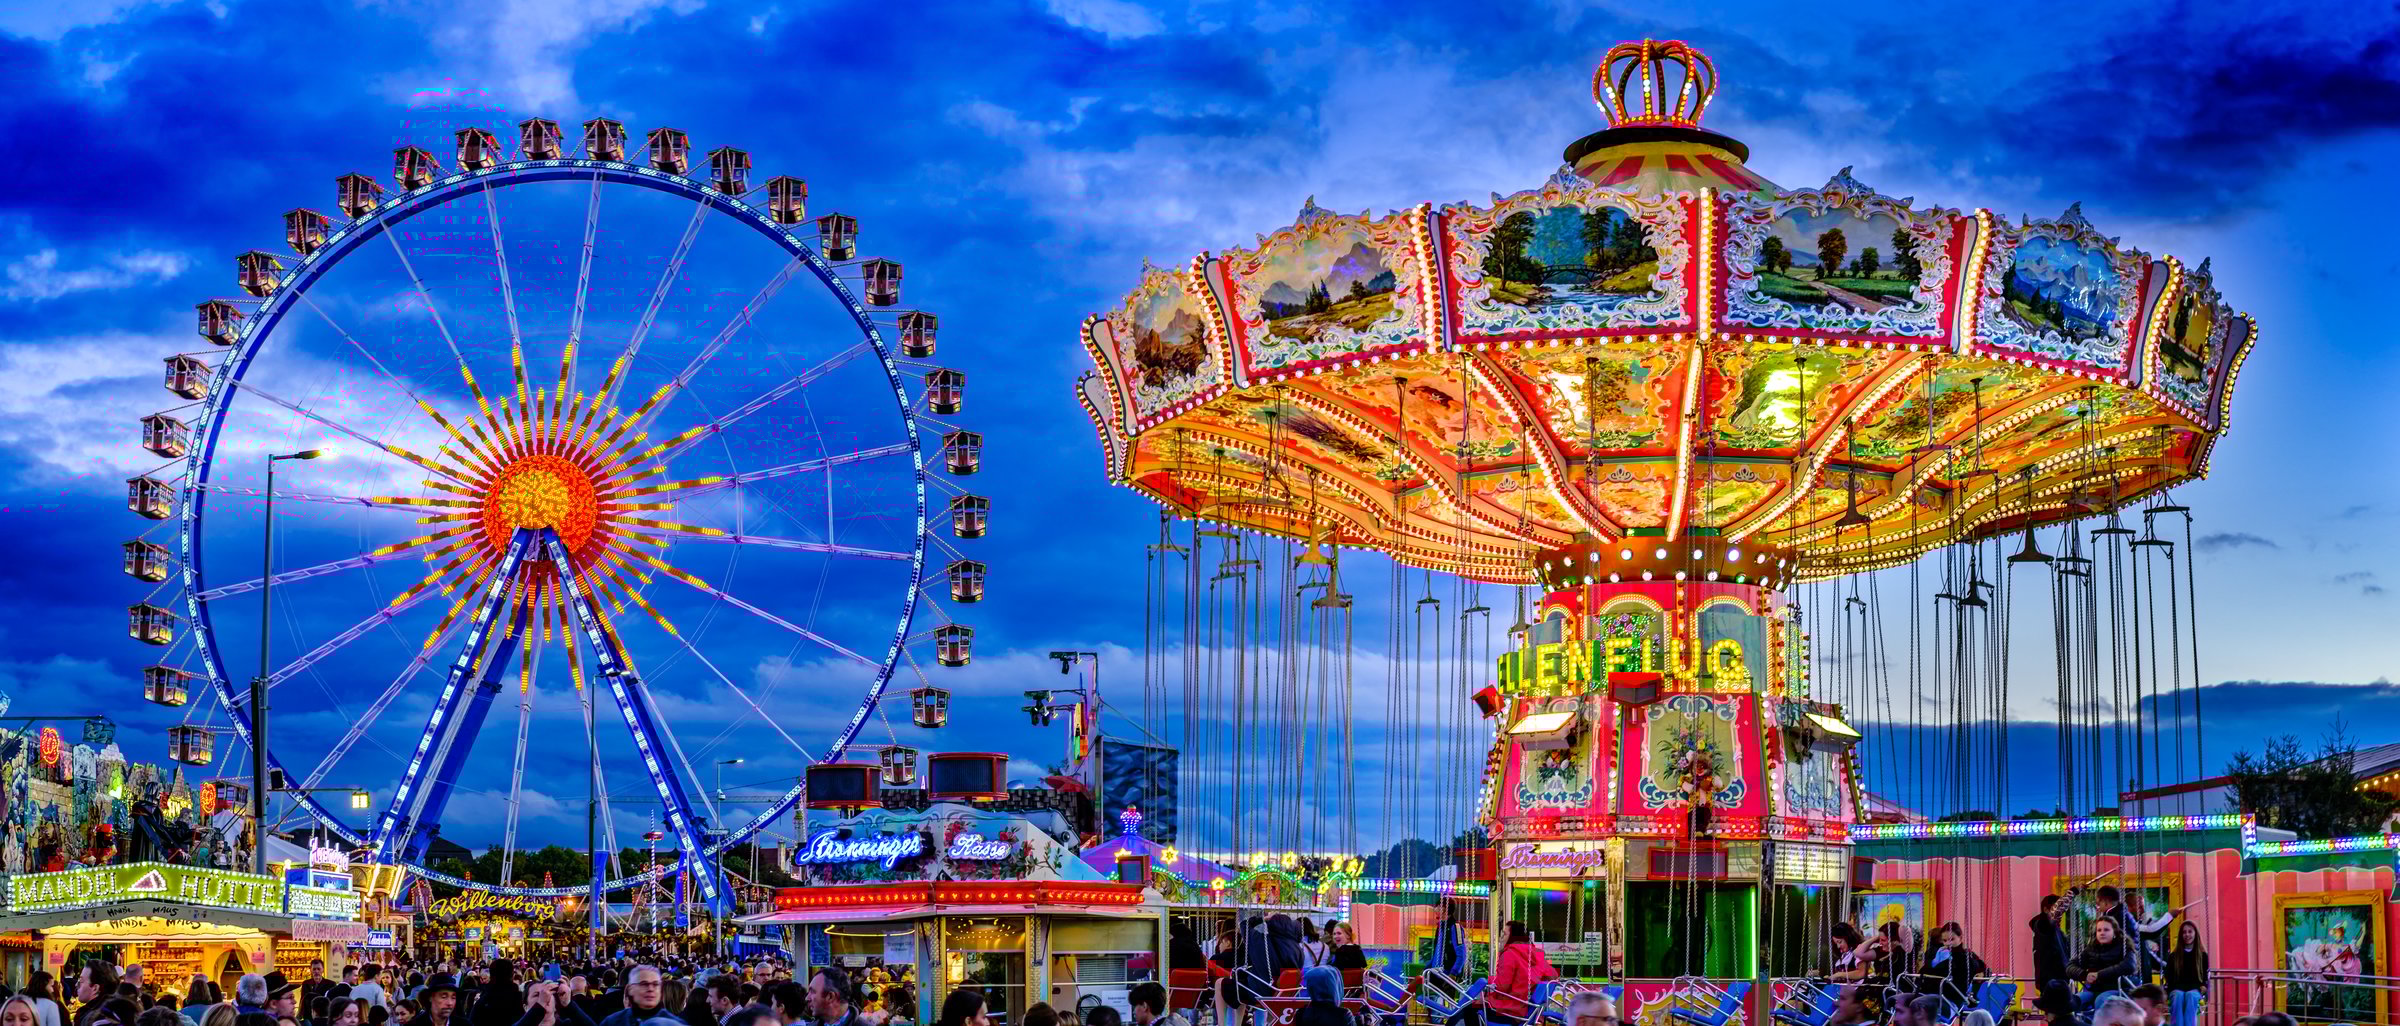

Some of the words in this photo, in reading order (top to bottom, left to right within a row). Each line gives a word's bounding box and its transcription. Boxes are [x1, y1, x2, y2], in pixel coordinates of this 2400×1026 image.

[949, 834, 1011, 859] Kasse
[1500, 843, 1602, 877] Stranninger
[18, 872, 125, 904] MANDEL
[179, 872, 276, 907] HÜTTE
[428, 889, 555, 920] Willenborg
